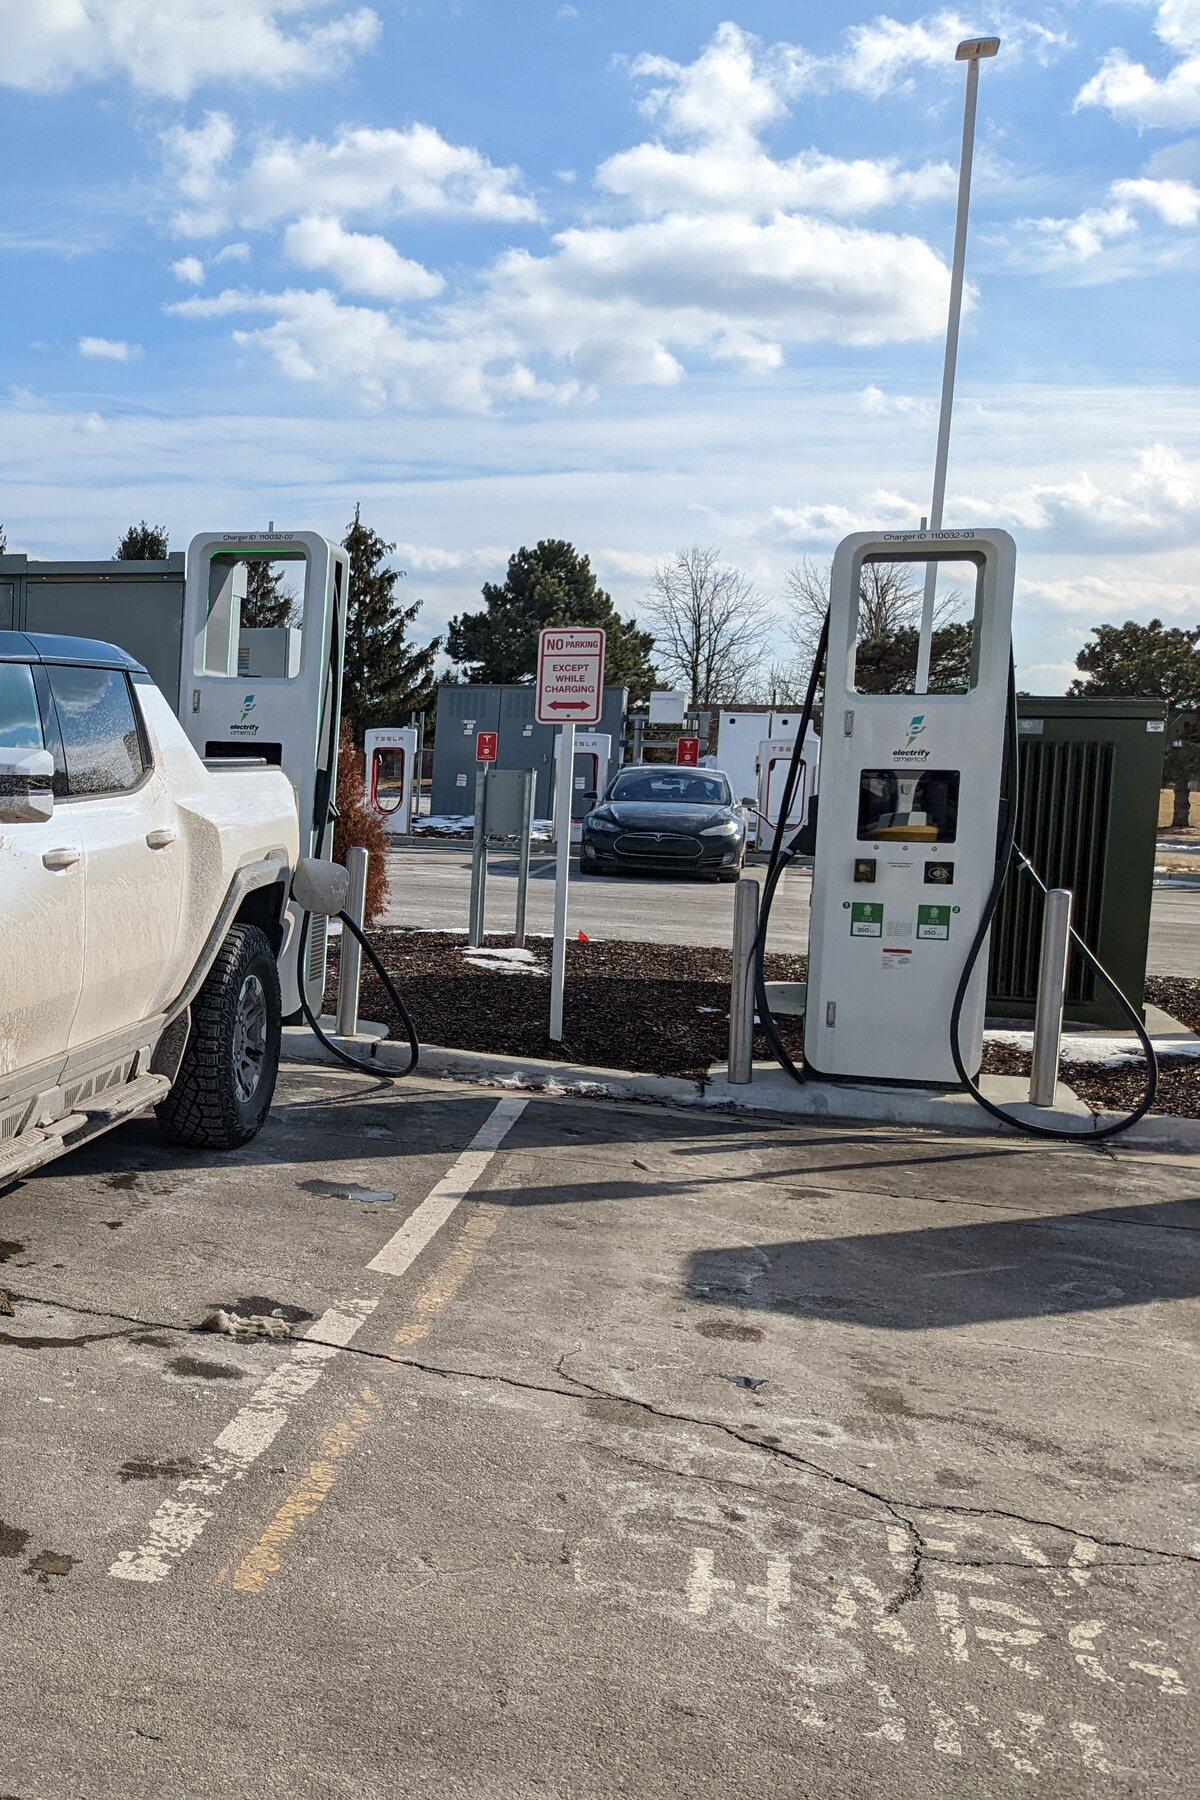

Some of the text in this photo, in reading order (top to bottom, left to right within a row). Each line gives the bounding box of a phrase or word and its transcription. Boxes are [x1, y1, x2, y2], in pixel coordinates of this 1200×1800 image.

[222, 534, 248, 542] Charger
[883, 533, 916, 541] Charger
[930, 531, 975, 539] 110032-03
[546, 639, 598, 651] NO PARKING
[552, 664, 590, 672] EXCEPT
[544, 685, 595, 693] CHARGING
[229, 723, 260, 732] electrify
[892, 749, 931, 758] electrify
